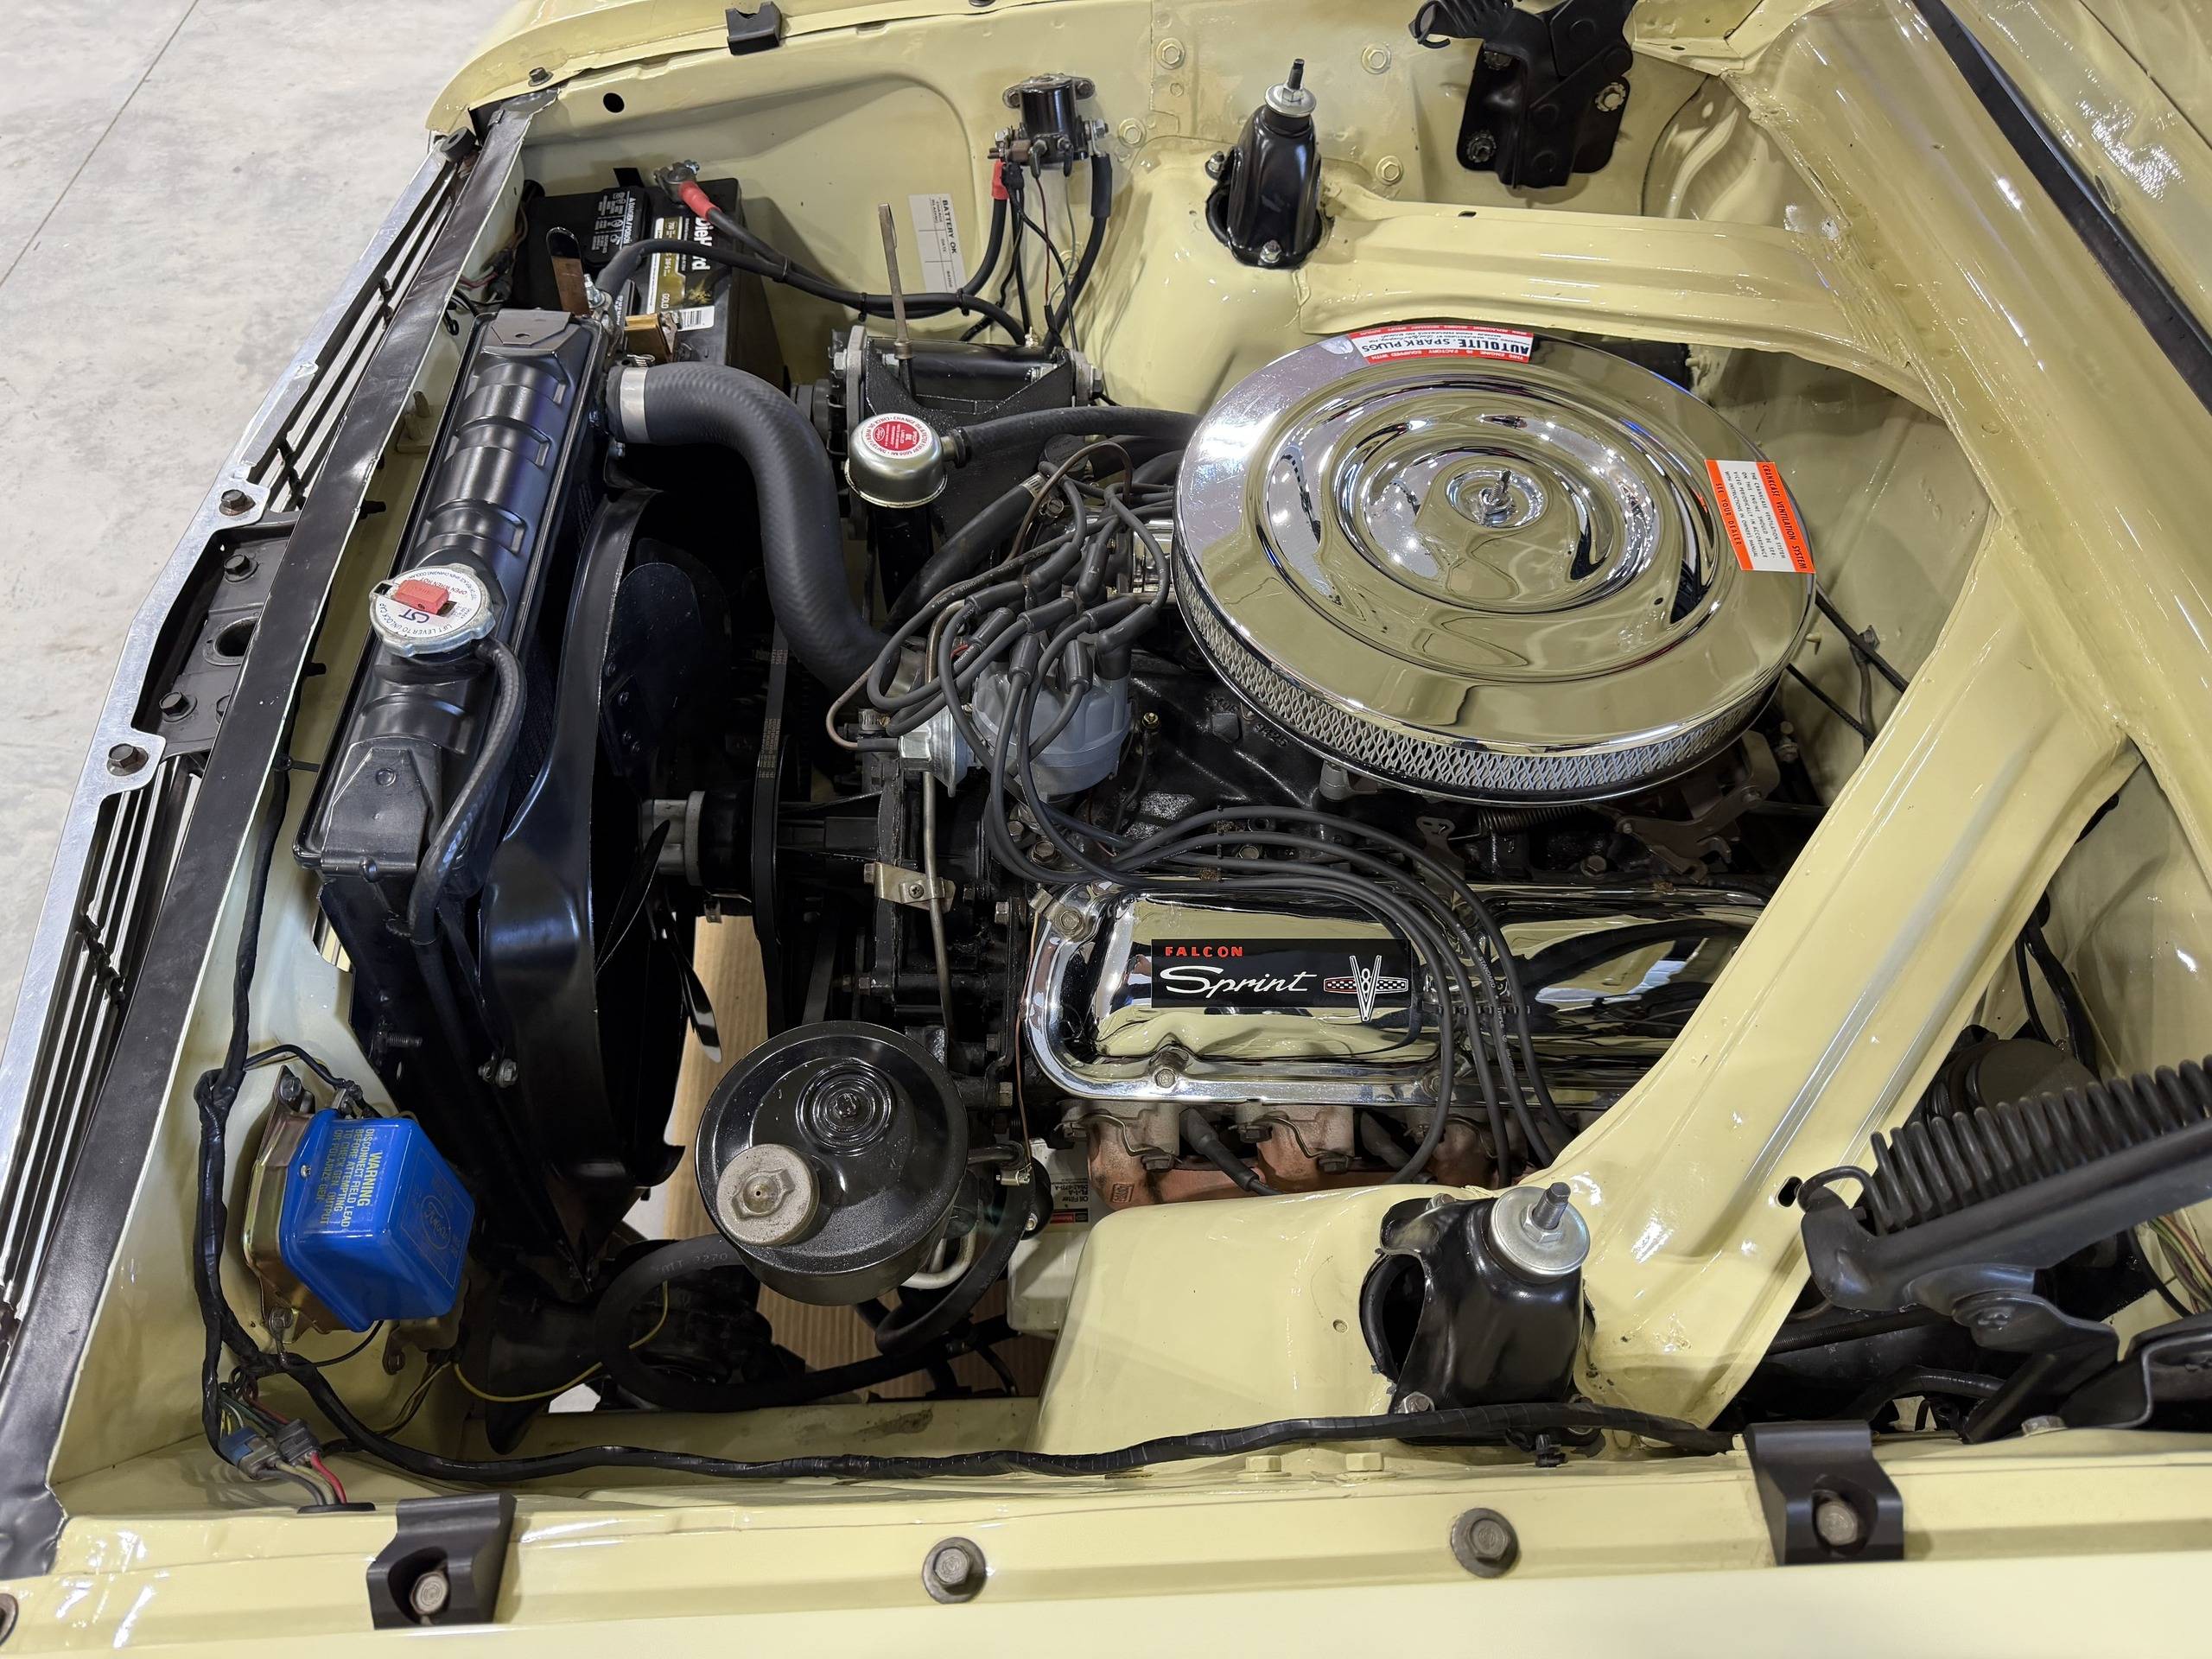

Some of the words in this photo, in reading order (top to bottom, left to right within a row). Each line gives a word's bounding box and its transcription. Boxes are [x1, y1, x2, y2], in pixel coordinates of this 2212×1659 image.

[943, 200, 954, 238] BATTERY
[950, 242, 957, 254] OK
[692, 217, 714, 270] DieHrd
[661, 293, 670, 308] GOLD
[1362, 341, 1402, 352] PLUGS
[1404, 339, 1450, 347] SPARK
[1728, 483, 1743, 512] INSTRUCTIONS
[1720, 499, 1732, 517] YOUR
[1728, 520, 1742, 546] DEALER
[1738, 487, 1753, 517] PERIODICALLY
[1751, 526, 1769, 558] ACCORDANCE
[1750, 494, 1760, 512] ENGINE
[1758, 516, 1768, 534] SHOULD
[1754, 482, 1767, 509] CRANKCASE
[1764, 512, 1779, 540] VENTILATION
[1776, 542, 1786, 559] SYSTEM
[1762, 465, 1780, 498] CRANKCASE
[1776, 500, 1797, 541] VENTILATION
[1791, 545, 1807, 569] SYSTEM
[432, 581, 451, 591] WHEN
[383, 614, 402, 630] UNLOCK
[398, 608, 429, 623] CST
[1165, 947, 1243, 957] FALCON
[1160, 966, 1318, 999] Sprint
[1478, 957, 1497, 988] STANDARD
[333, 1129, 342, 1140] OR
[345, 1129, 353, 1139] TO
[349, 1129, 363, 1159] BEFORE
[321, 1144, 338, 1180] POLARIZE
[336, 1142, 350, 1166] CHECK
[355, 1129, 374, 1177] DISCONNECT
[334, 1161, 354, 1211] ATTEMPTING
[347, 1181, 359, 1203] FIELD
[358, 1152, 382, 1206] WARNING
[320, 1192, 336, 1224] OUTPUT
[341, 1206, 353, 1227] LEAD
